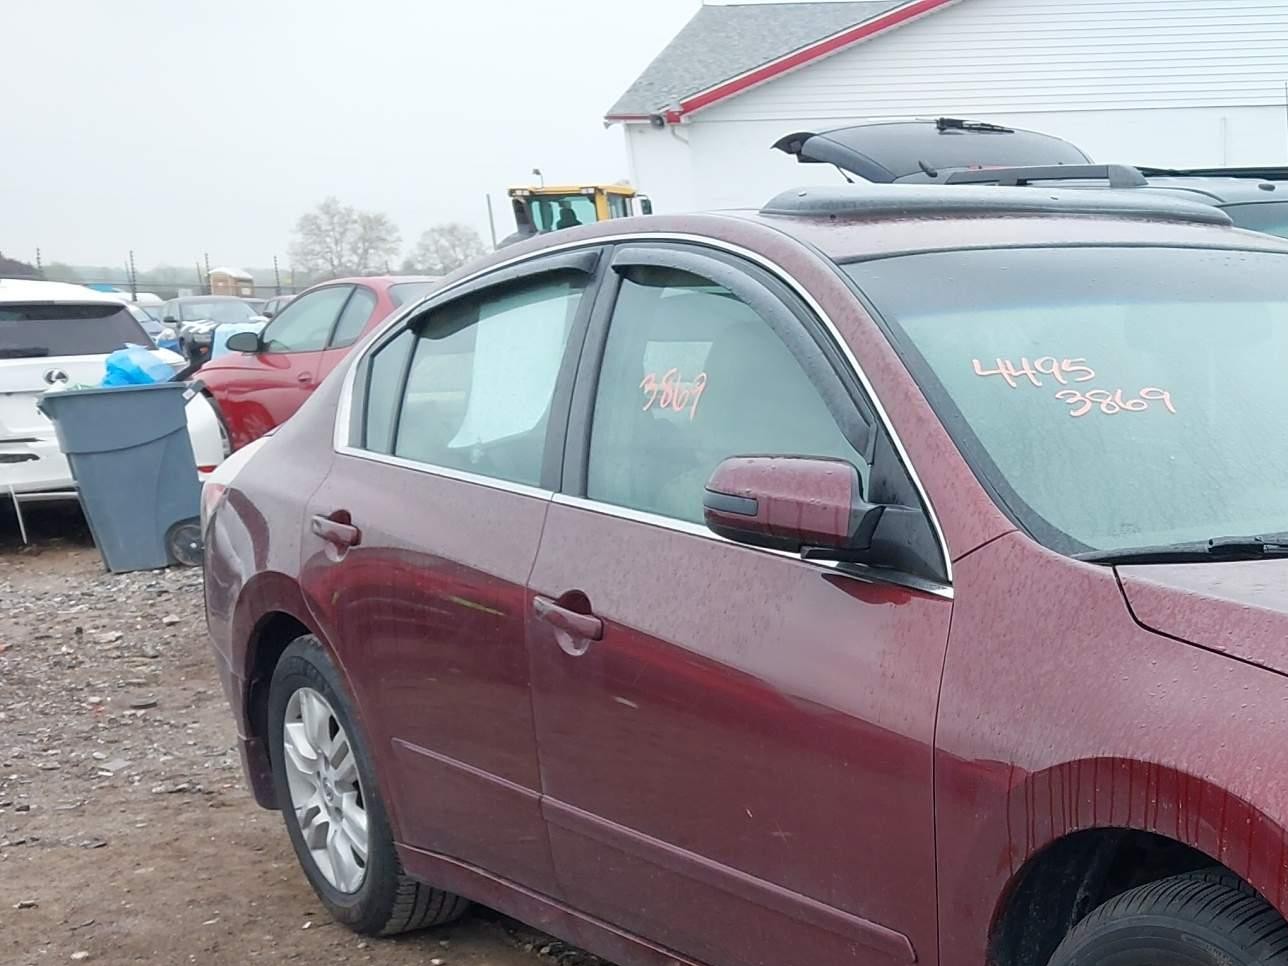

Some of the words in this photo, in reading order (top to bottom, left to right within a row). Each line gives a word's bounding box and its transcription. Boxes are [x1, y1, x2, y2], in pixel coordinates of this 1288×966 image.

[971, 356, 1096, 388] 4495
[639, 368, 708, 424] 3869
[1054, 387, 1177, 417] 3869
